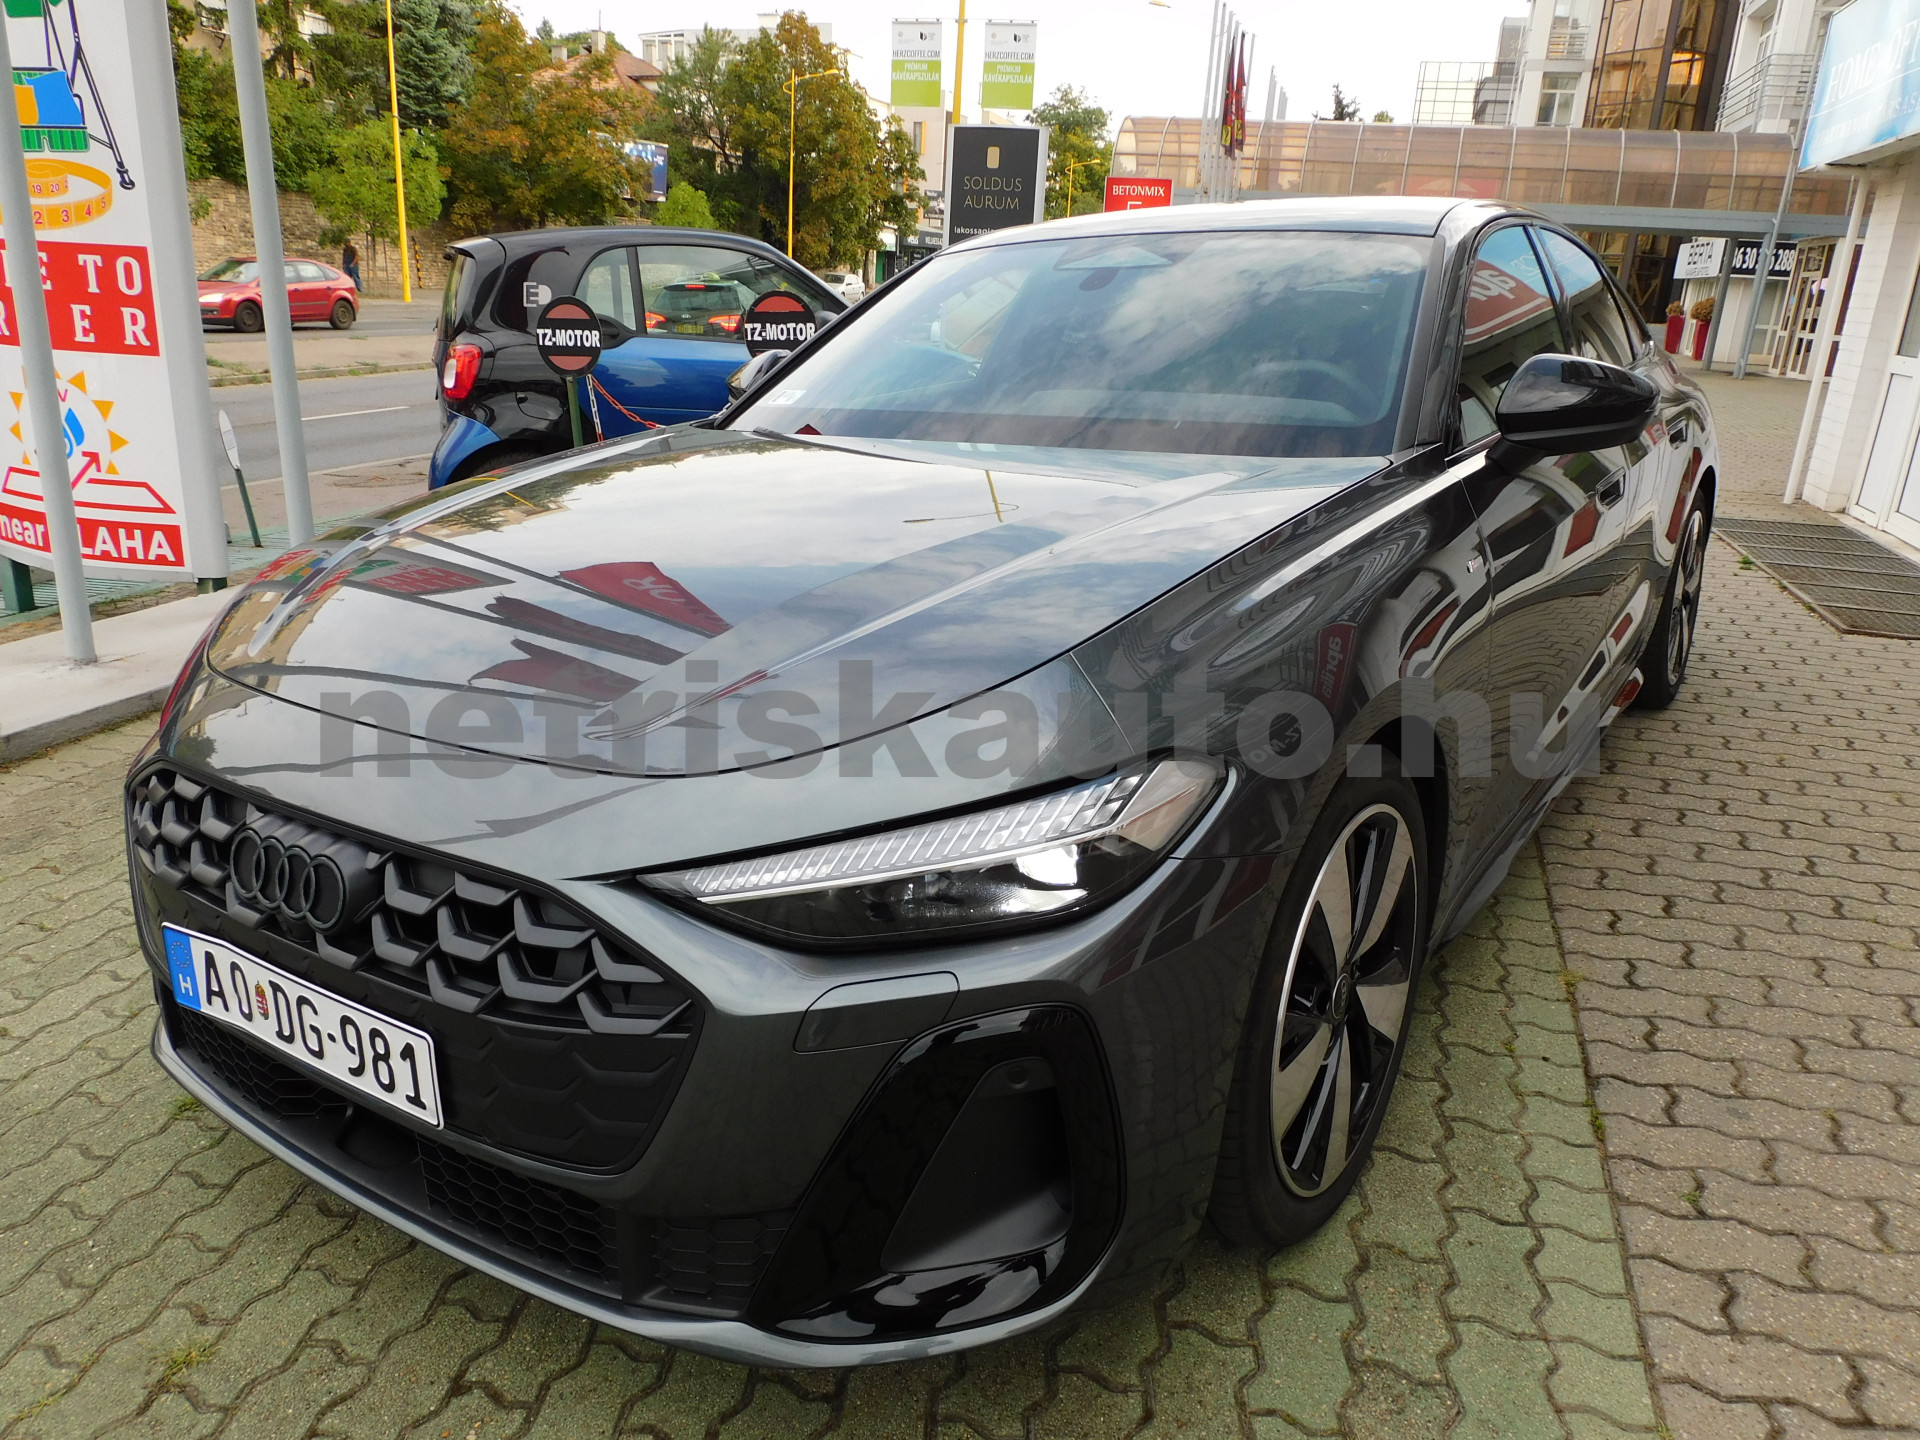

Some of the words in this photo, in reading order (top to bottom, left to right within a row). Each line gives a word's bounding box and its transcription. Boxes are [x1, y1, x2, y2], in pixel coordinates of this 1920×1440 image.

[892, 49, 941, 58] HERZCOFFEE.COM
[984, 51, 1035, 60] HERZCOFFEE.COM
[32, 184, 42, 194] 19
[50, 183, 60, 193] 20
[963, 175, 1023, 192] SOLDUS
[1112, 184, 1165, 198] BETONMIX
[963, 194, 1020, 211] AURUM
[1687, 241, 1714, 266] BERTA
[77, 253, 143, 296] TO
[536, 328, 601, 348] TZ-MOTOR
[744, 322, 816, 341] TZ-MOTOR
[0, 514, 46, 547] near
[178, 973, 194, 997] H
